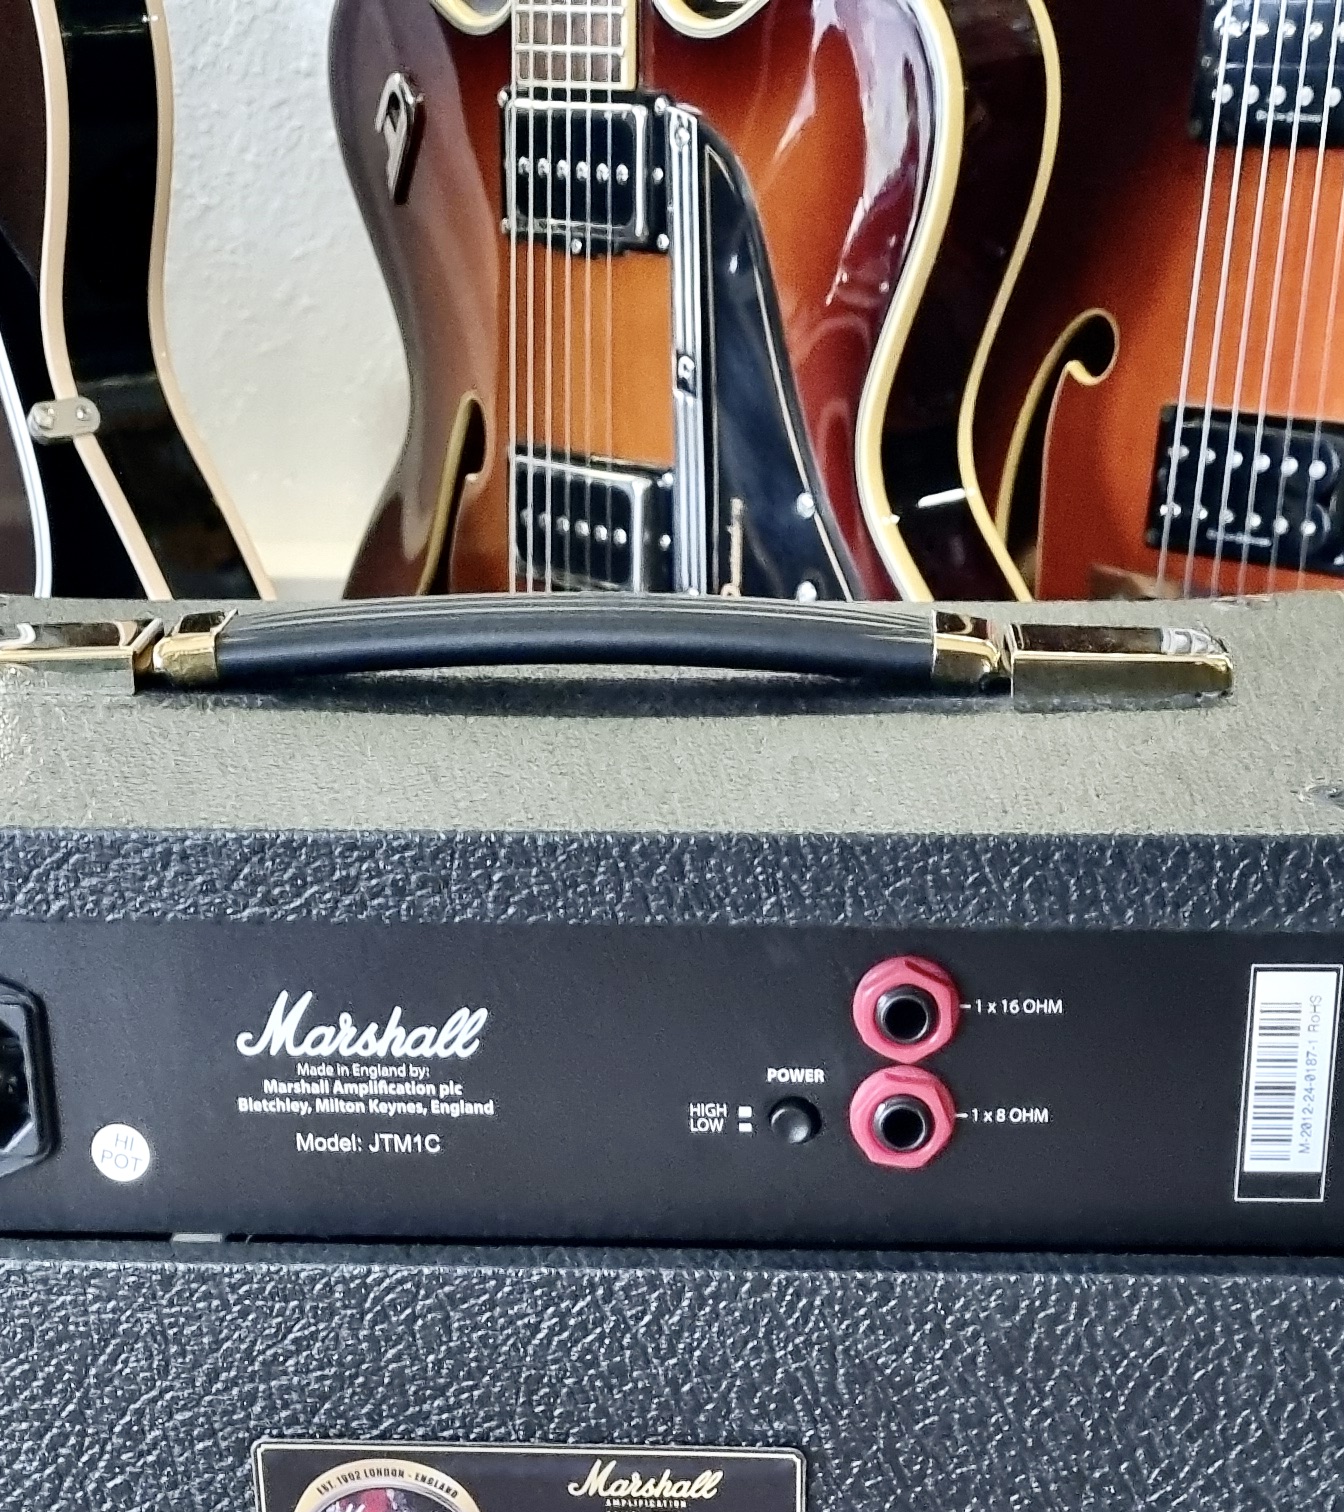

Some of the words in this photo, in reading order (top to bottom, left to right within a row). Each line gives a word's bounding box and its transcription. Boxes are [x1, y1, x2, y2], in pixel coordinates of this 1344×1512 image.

[976, 999, 982, 1014] 1
[1002, 999, 1020, 1014] 16
[1023, 999, 1063, 1014] OHM
[1308, 995, 1323, 1033] RoHS
[236, 989, 488, 1058] Marshall
[297, 1062, 334, 1077] Made
[337, 1062, 350, 1077] in
[352, 1063, 407, 1080] England
[409, 1063, 430, 1080] by:
[767, 1067, 825, 1083] POWER
[263, 1078, 330, 1095] Marshall
[333, 1079, 436, 1098] Amplification
[439, 1079, 464, 1099] plc
[237, 1097, 313, 1116] Bletchley,
[315, 1098, 366, 1114] Milton
[369, 1098, 428, 1117] Keynes,
[431, 1099, 494, 1118] England
[689, 1103, 727, 1117] HIGH
[971, 1108, 978, 1122] 1
[996, 1108, 1006, 1123] 8
[1009, 1107, 1049, 1123] OHM
[690, 1118, 724, 1132] LOW
[115, 1133, 134, 1151] HI
[296, 1131, 362, 1152] Model:
[368, 1132, 441, 1153] JTM1C
[101, 1148, 143, 1172] POT
[363, 1467, 405, 1479] LONDON
[568, 1459, 724, 1499] Marshall
